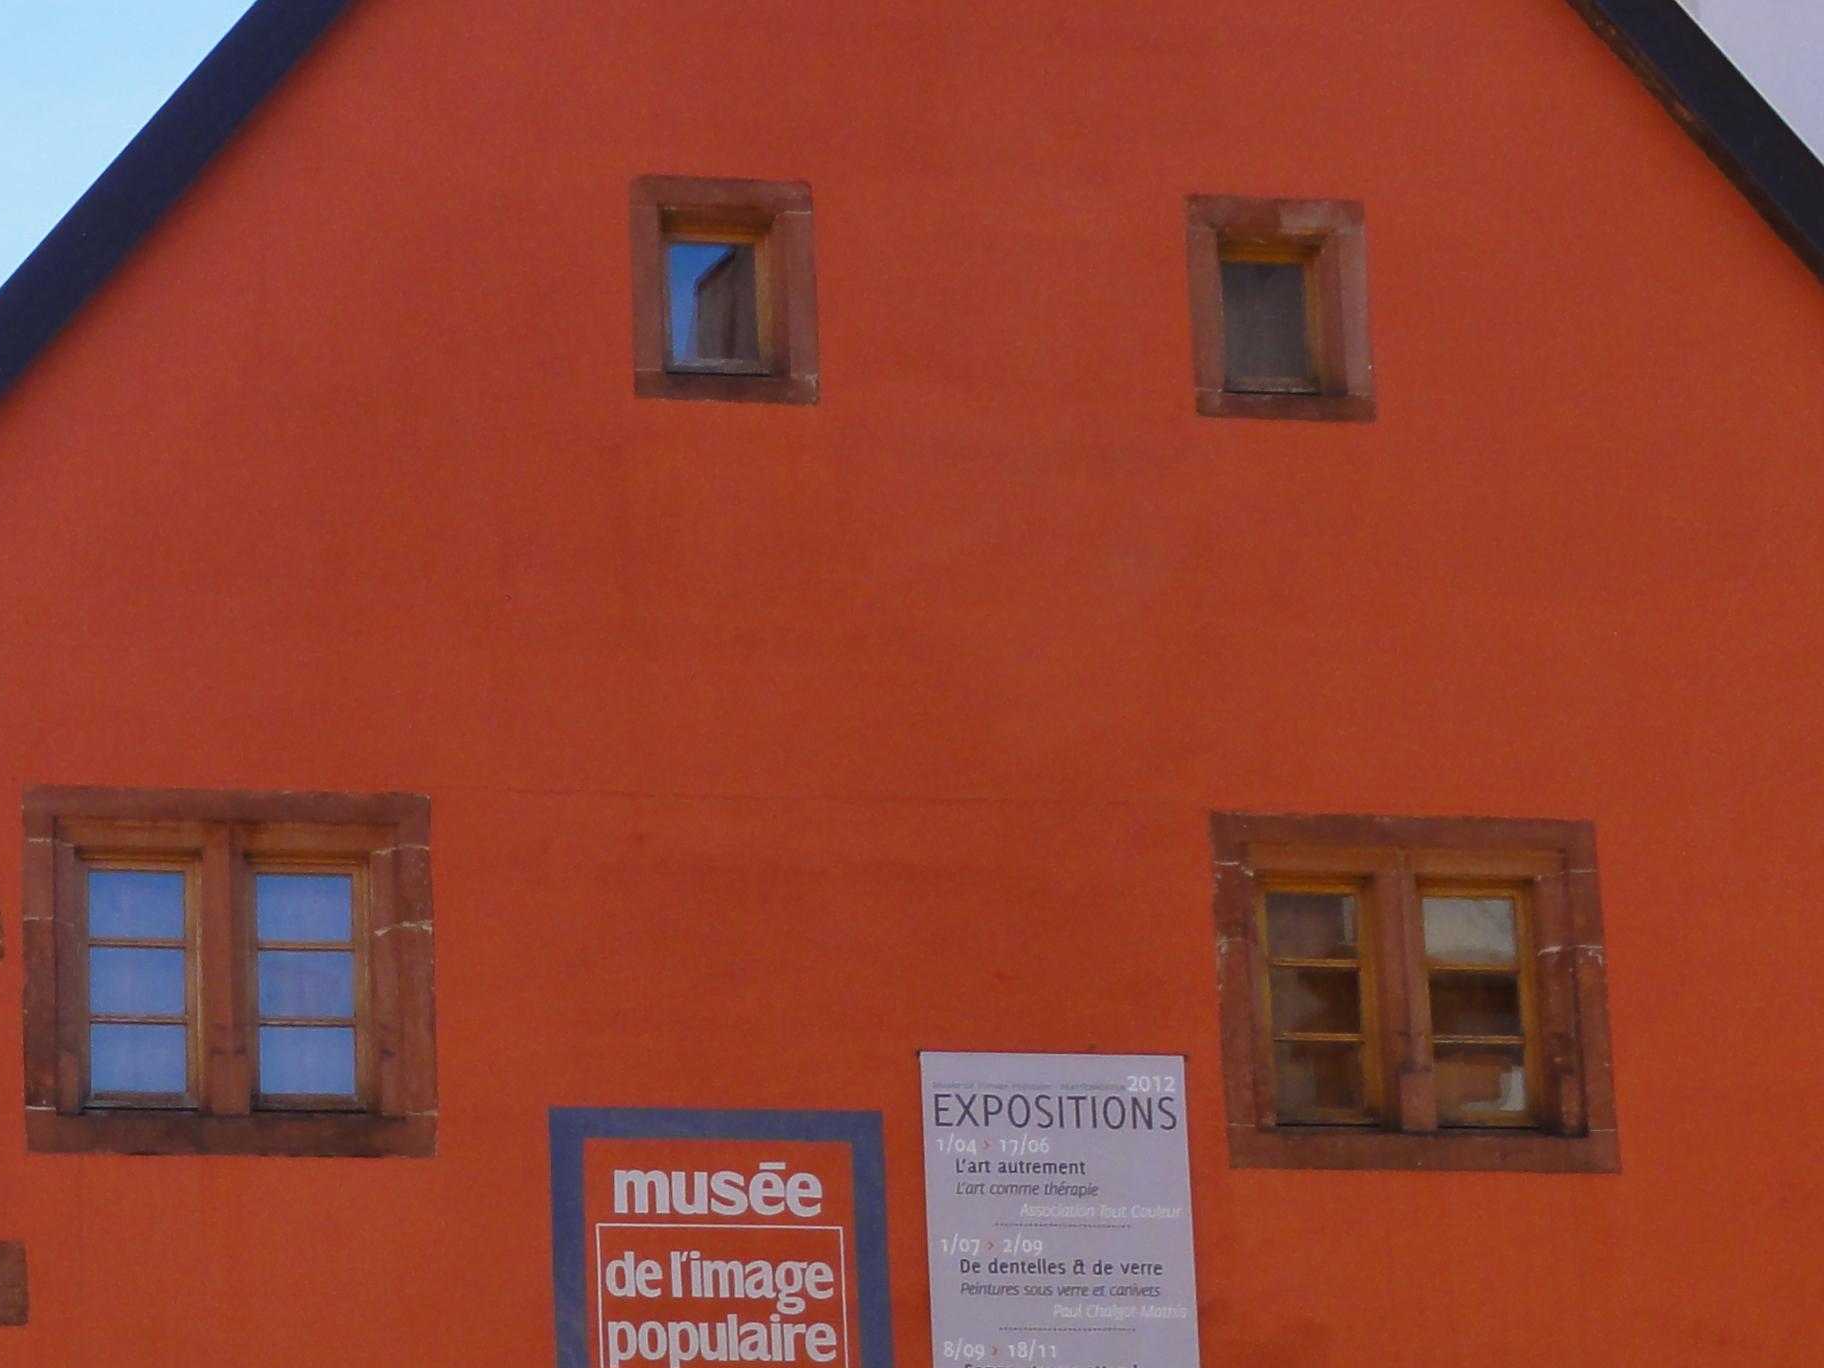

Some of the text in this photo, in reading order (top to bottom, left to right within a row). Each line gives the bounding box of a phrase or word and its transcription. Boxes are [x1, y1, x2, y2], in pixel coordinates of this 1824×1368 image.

[1126, 1075, 1176, 1092] 2012
[933, 1093, 1177, 1131] EXPOSITIONS
[936, 1133, 1050, 1155] 1/04 17/06
[955, 1158, 1086, 1176] L'art autrement
[613, 1162, 823, 1217] musée
[956, 1180, 1100, 1198] L'art comme thérapie
[940, 1233, 1043, 1256] 1/07 2/09
[960, 1259, 981, 1274] De
[988, 1258, 1066, 1275] dentelles
[1093, 1260, 1113, 1275] de
[1120, 1262, 1163, 1276] verre
[605, 1250, 835, 1315] de l'image
[960, 1282, 1020, 1297] Peintures
[1023, 1284, 1054, 1297] sous
[1057, 1285, 1089, 1297] verre
[1092, 1285, 1105, 1297] et
[943, 1338, 1057, 1361] 8/09 18/11
